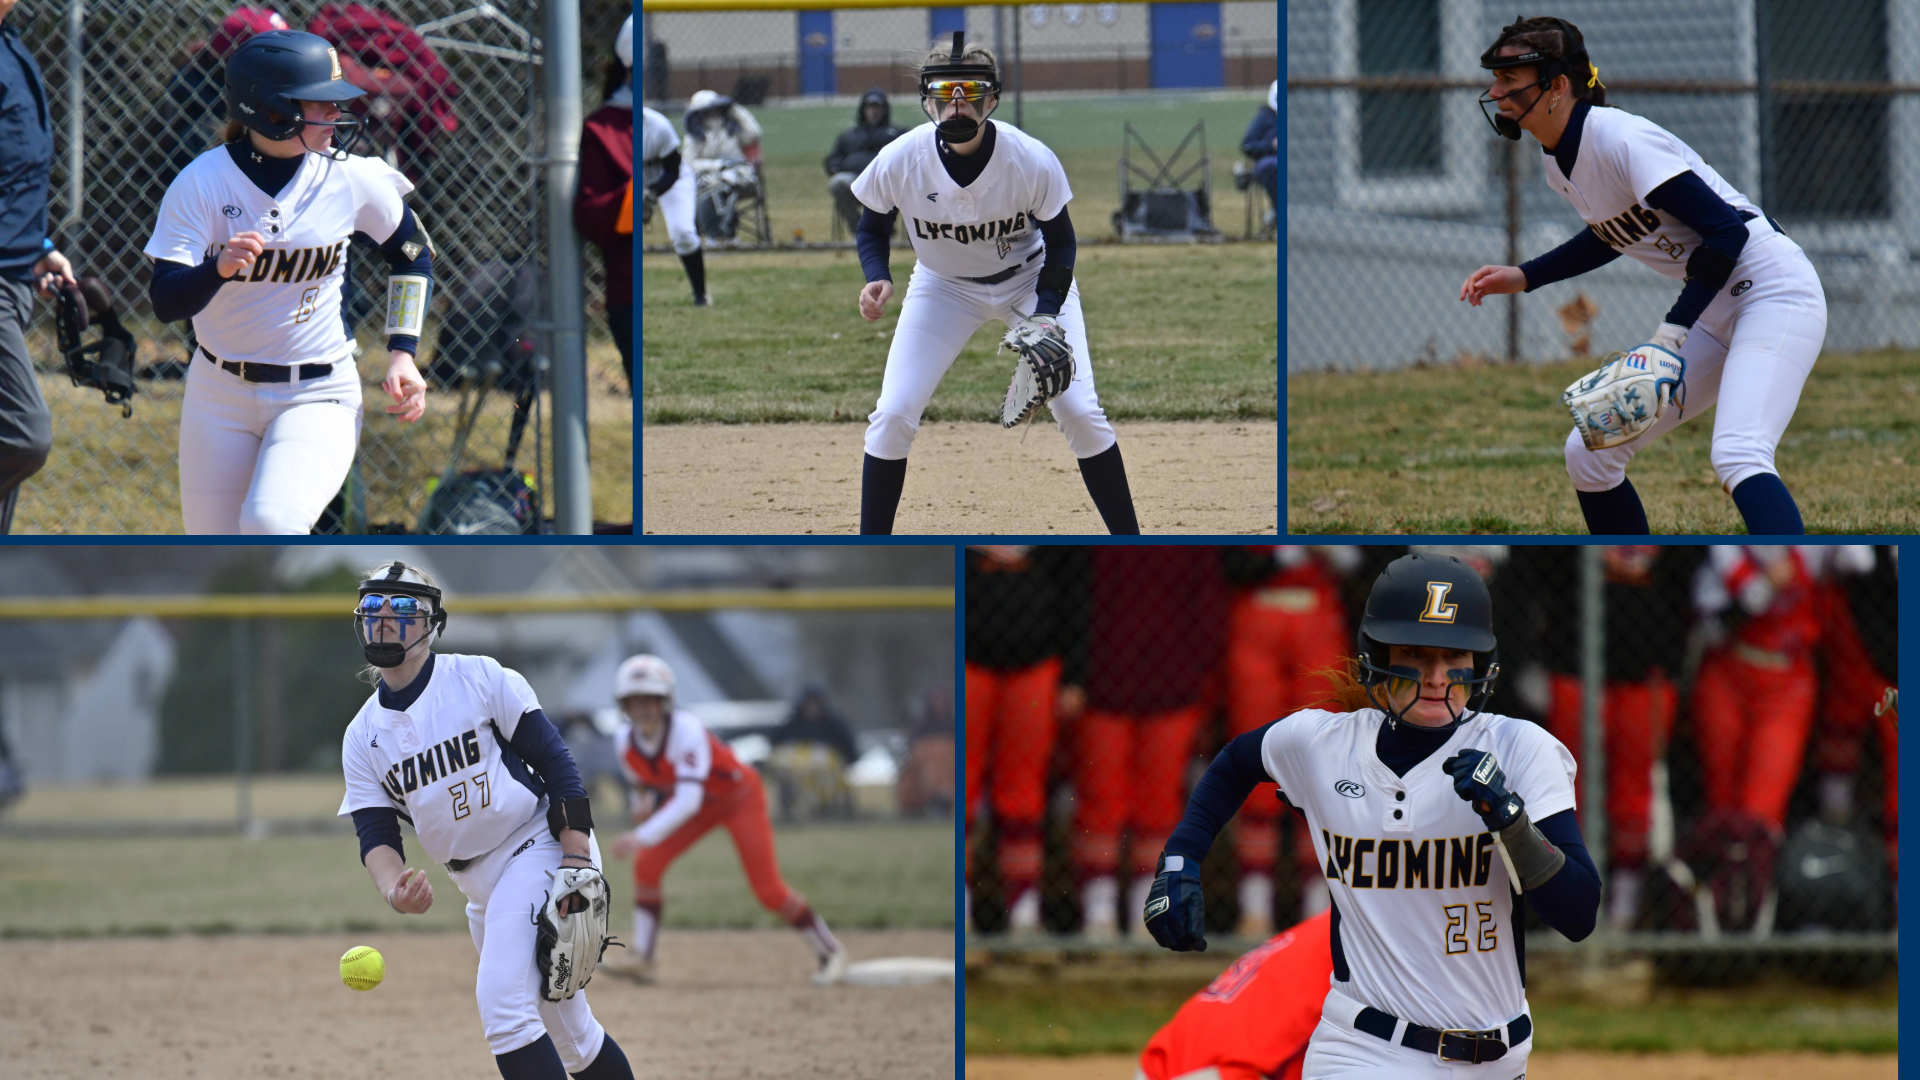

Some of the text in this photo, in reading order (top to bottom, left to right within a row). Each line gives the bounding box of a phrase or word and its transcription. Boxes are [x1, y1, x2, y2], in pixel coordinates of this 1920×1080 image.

[1589, 203, 1661, 248] MING
[210, 241, 343, 284] OMING
[295, 286, 319, 324] 8
[1419, 581, 1458, 624] L
[447, 771, 491, 821] 27
[1322, 828, 1495, 889] LYCOMING
[1442, 900, 1498, 956] 22
